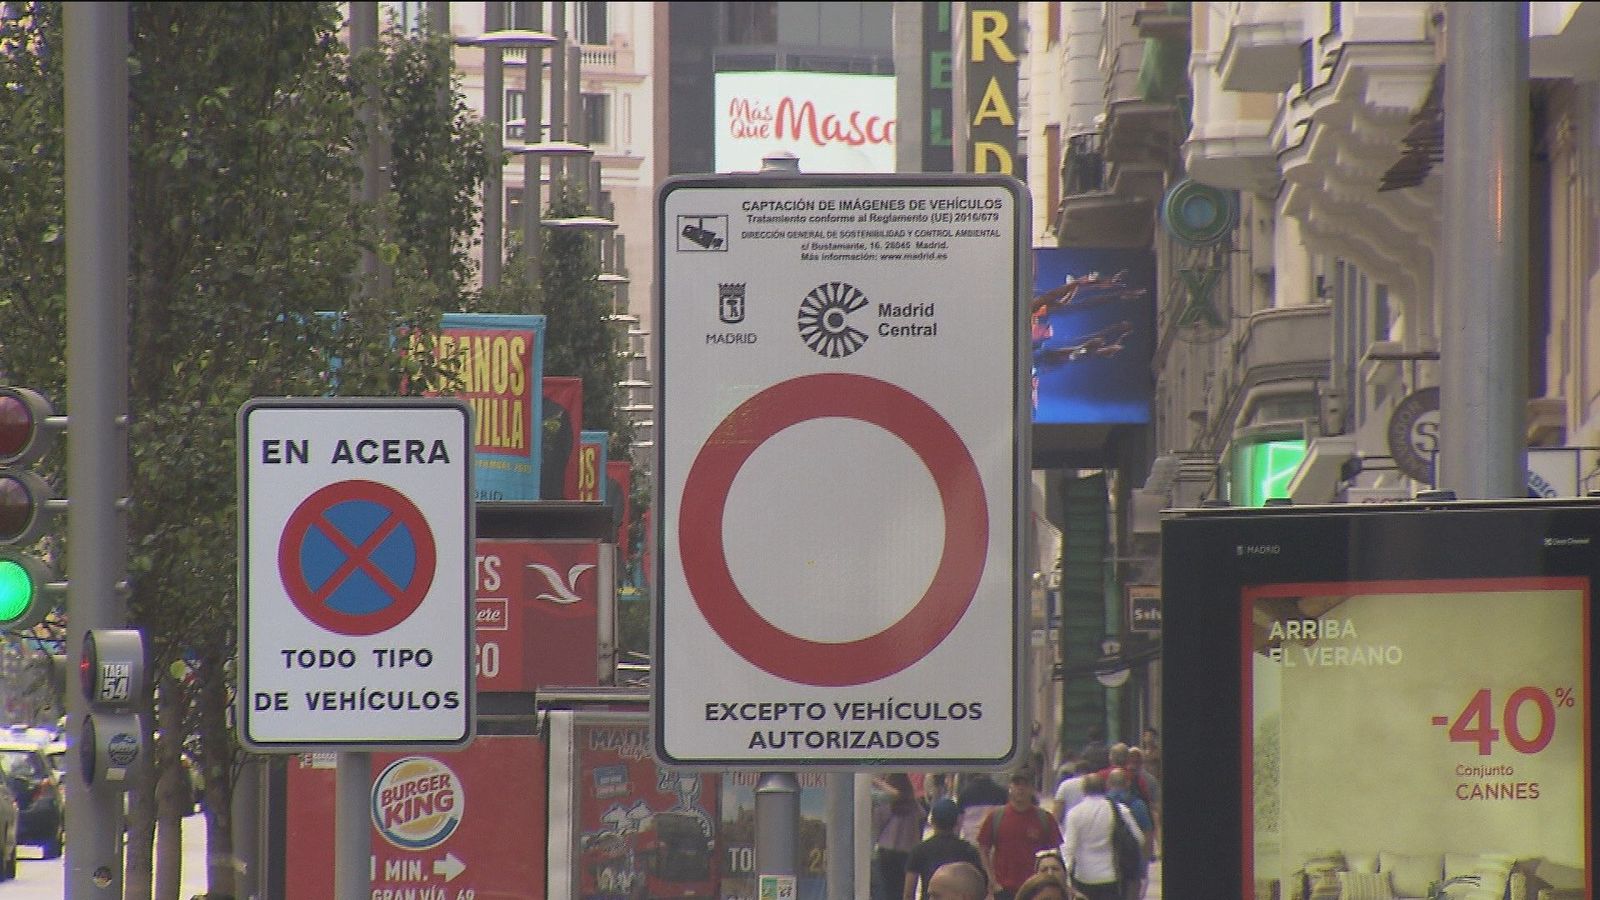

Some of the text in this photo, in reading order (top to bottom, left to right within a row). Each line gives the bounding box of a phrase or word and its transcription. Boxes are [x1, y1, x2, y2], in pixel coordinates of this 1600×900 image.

[729, 97, 773, 122] Más
[730, 118, 770, 139] Que
[742, 196, 1003, 211] CAPTACIÓN DE IMÁGENES DE VEHÍCULOS
[747, 212, 999, 224] Tratamiento conforme al Reglamento (UE) 2016/679
[741, 229, 786, 239] DIRECCIÓN
[786, 230, 826, 239] GENERAL
[827, 230, 838, 238] DE
[840, 229, 906, 238] SOSTENIBILIDAD
[914, 229, 953, 238] CONTROL
[955, 229, 1001, 238] AMBIENTAL
[812, 241, 867, 251] Bustamante,
[916, 240, 949, 249] Madrid.
[801, 251, 949, 261] Más información: www.madrid.es
[878, 302, 935, 318] Madrid
[706, 332, 758, 345] MADRID
[878, 322, 938, 338] Central
[261, 439, 451, 465] EN ACERA
[1268, 619, 1358, 641] ARRIBA
[281, 649, 434, 669] TODO TIPO
[1269, 644, 1403, 669] EL VERANO
[101, 677, 130, 700] 54
[253, 686, 460, 711] DE VEHÍCULOS
[704, 697, 983, 721] EXCEPTO VEHÍCULOS
[747, 730, 940, 750] AUTORIZADOS
[1456, 764, 1515, 778] Conjunto
[381, 772, 451, 808] BURGER
[1456, 783, 1541, 801] CANNES
[382, 789, 455, 831] KING
[384, 860, 429, 882] MIN.
